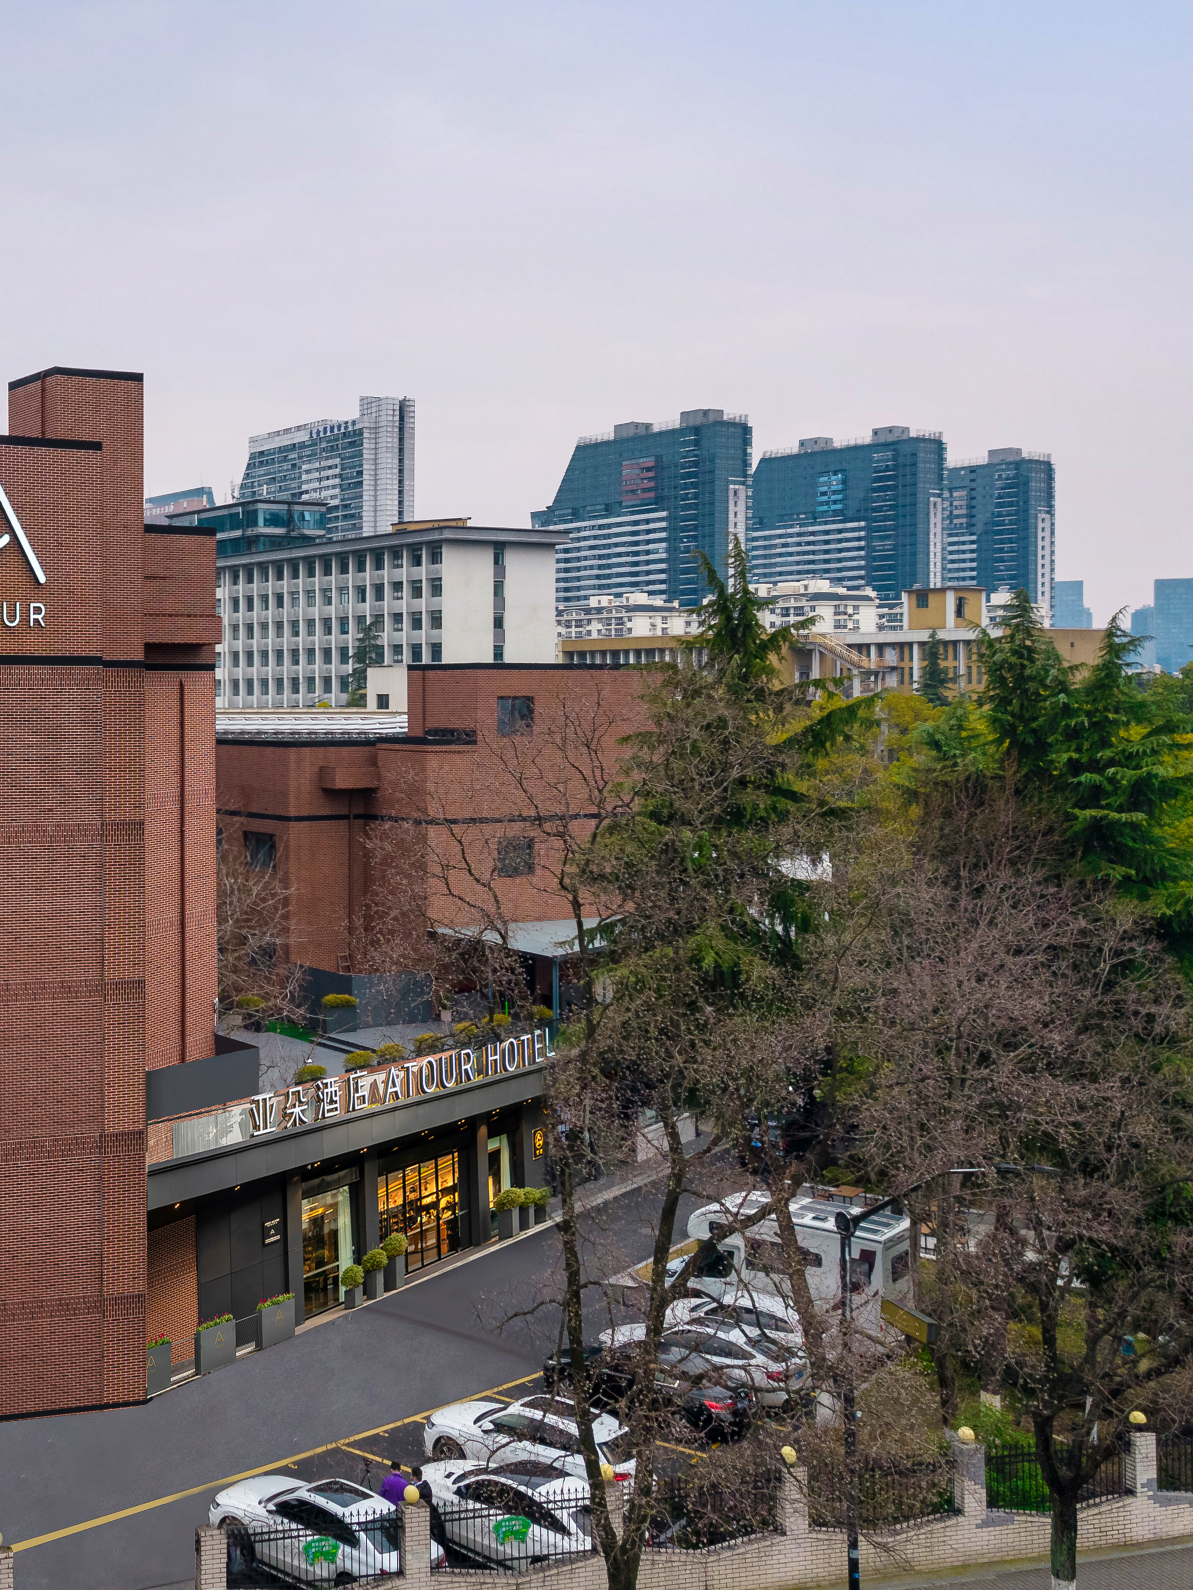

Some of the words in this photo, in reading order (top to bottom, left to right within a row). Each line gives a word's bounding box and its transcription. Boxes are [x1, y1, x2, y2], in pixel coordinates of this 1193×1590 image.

[251, 1070, 369, 1137] 亚朵酒店
[385, 1048, 476, 1105] ATOUR
[487, 1027, 556, 1076] HOTEL
